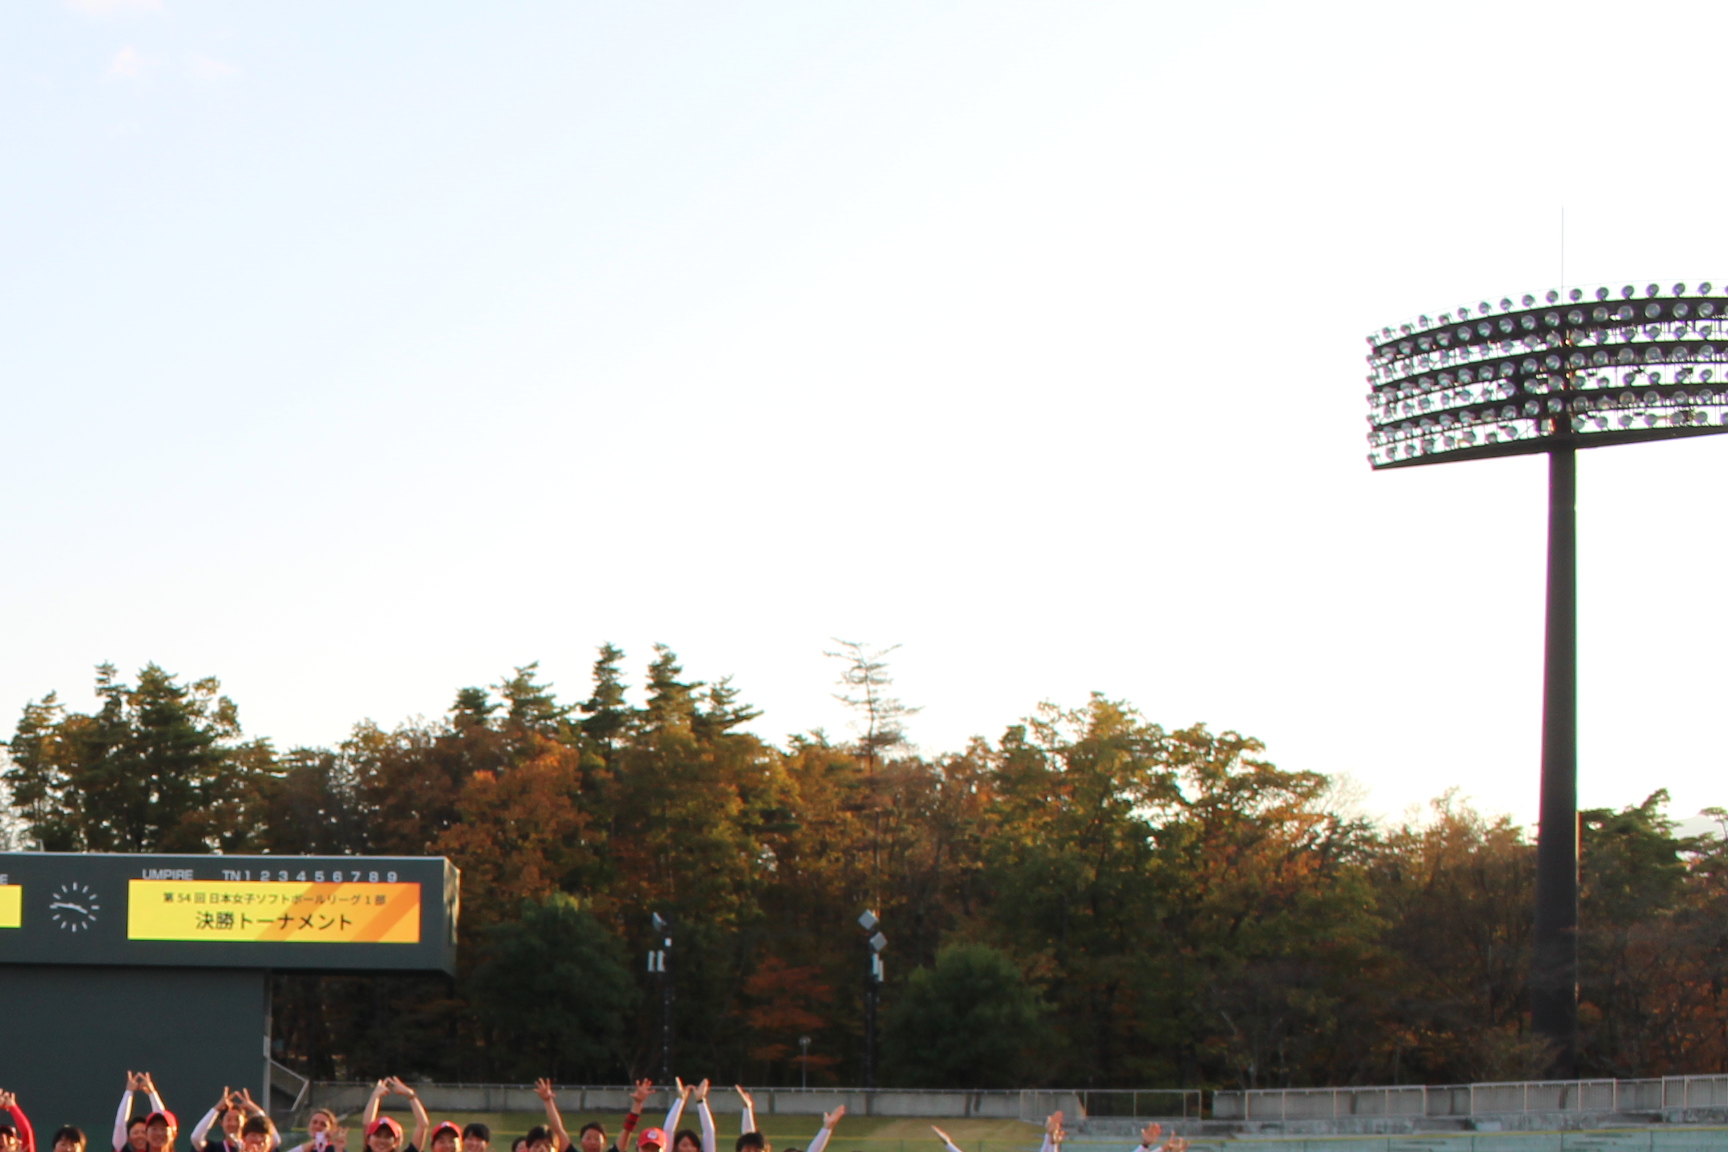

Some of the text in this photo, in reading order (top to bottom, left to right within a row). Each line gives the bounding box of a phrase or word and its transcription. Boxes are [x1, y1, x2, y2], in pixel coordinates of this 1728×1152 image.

[0, 874, 9, 885] E
[142, 869, 398, 883] UMPIRE TN 1 2 3 4 5 6 7 8 9
[195, 910, 352, 931] 決勝トーナメント
